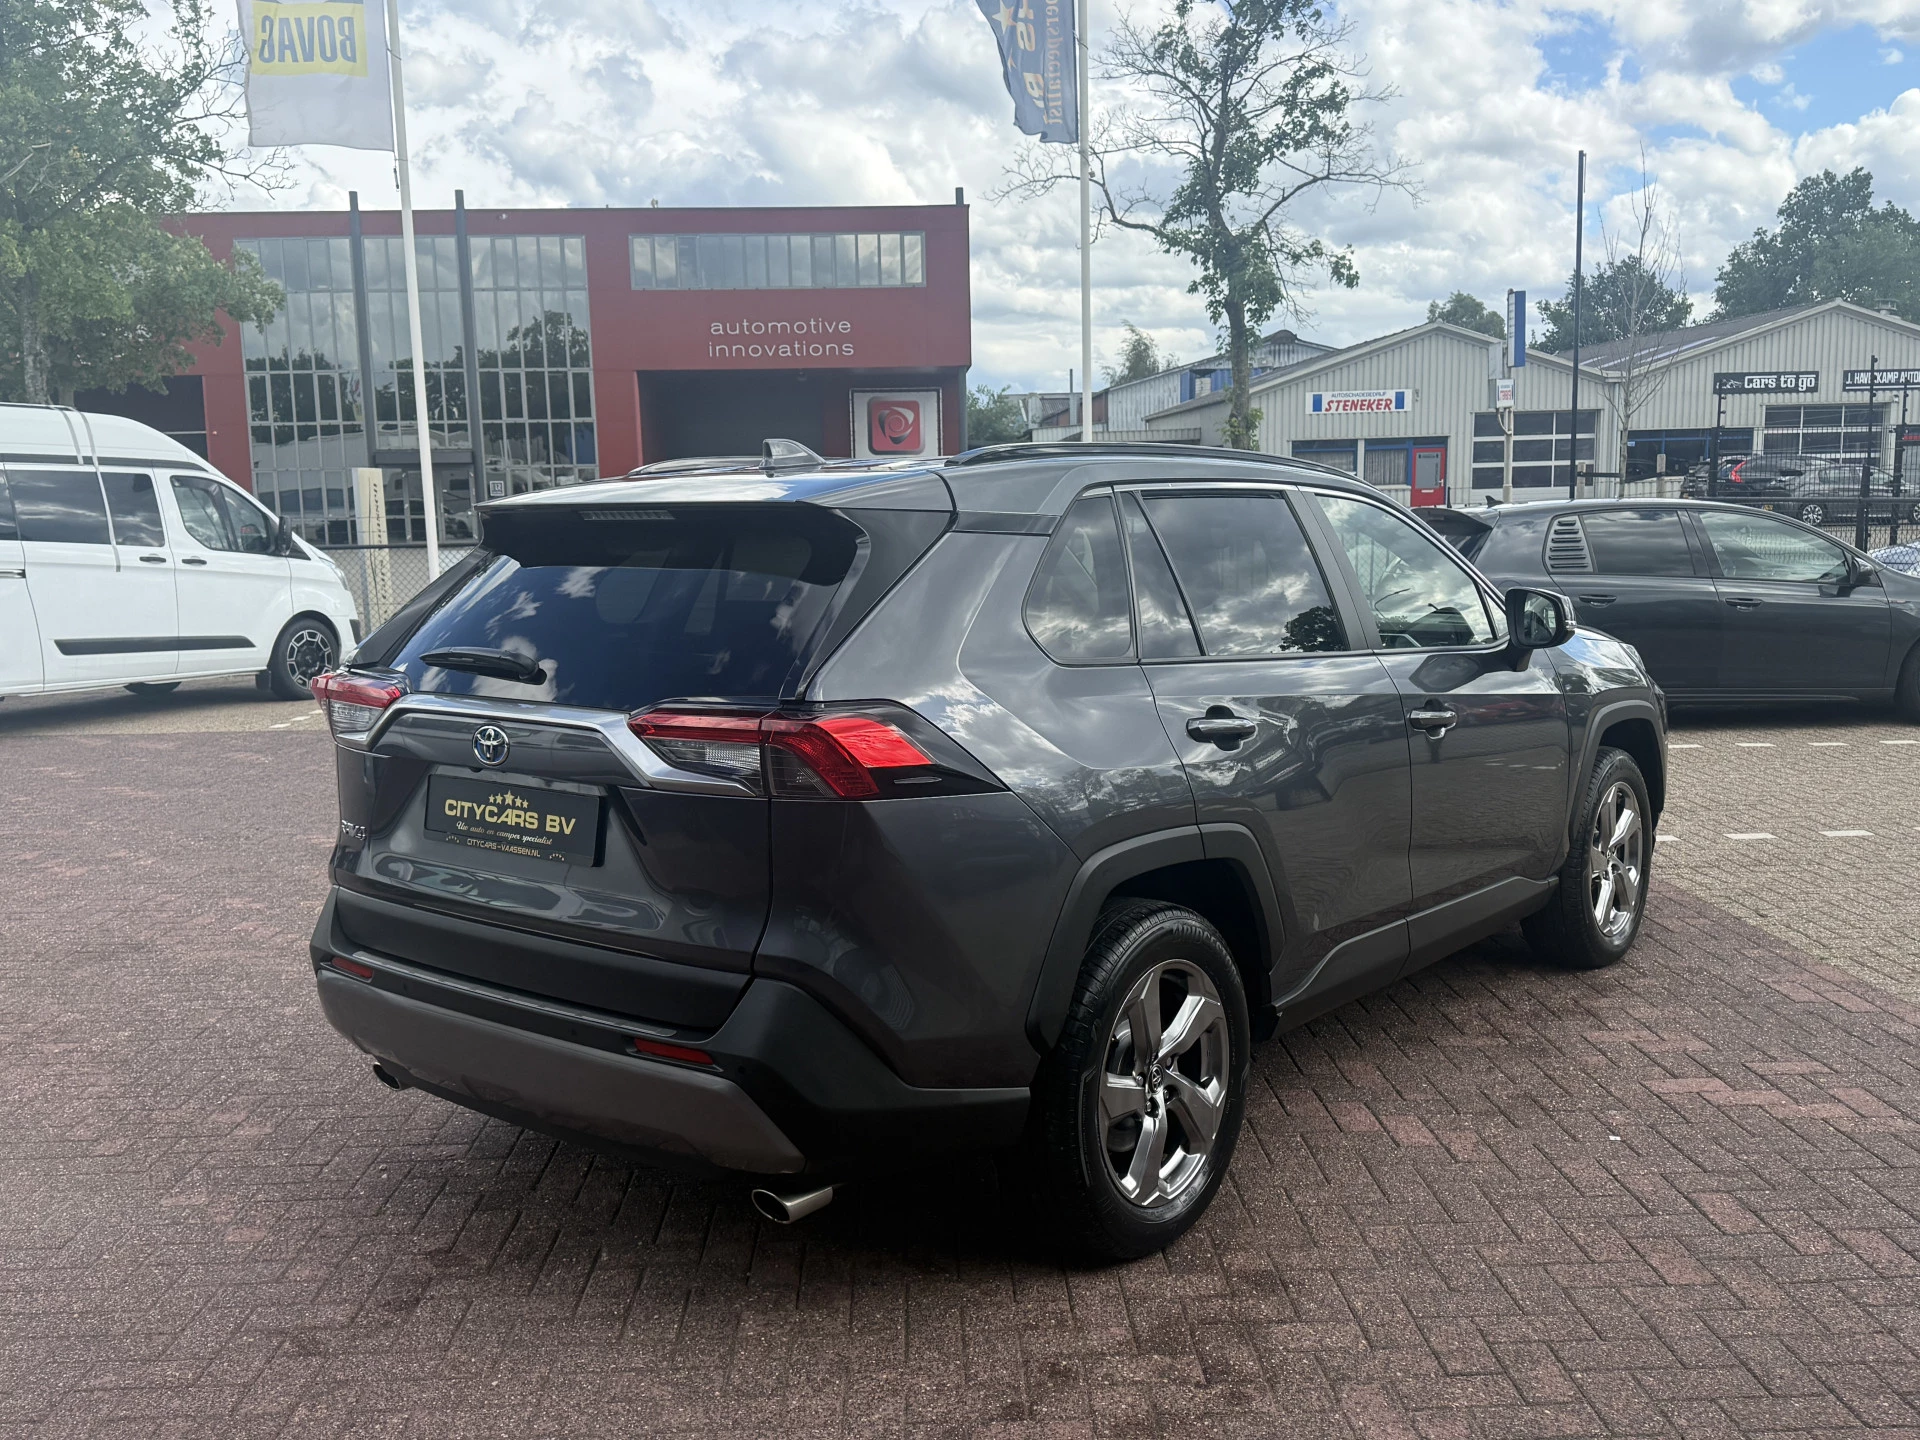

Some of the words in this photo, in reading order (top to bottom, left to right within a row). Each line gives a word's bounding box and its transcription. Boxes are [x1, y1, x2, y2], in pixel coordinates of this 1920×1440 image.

[710, 318, 851, 335] automotive
[708, 341, 854, 357] innovations
[1744, 375, 1777, 389] Cars
[1780, 375, 1797, 388] to
[1798, 374, 1816, 391] go
[1324, 398, 1393, 412] STENEKER
[444, 799, 540, 829] CITYCARS
[545, 814, 577, 835] BV
[469, 826, 485, 834] auto
[496, 831, 521, 841] camper
[521, 834, 553, 846] specialist
